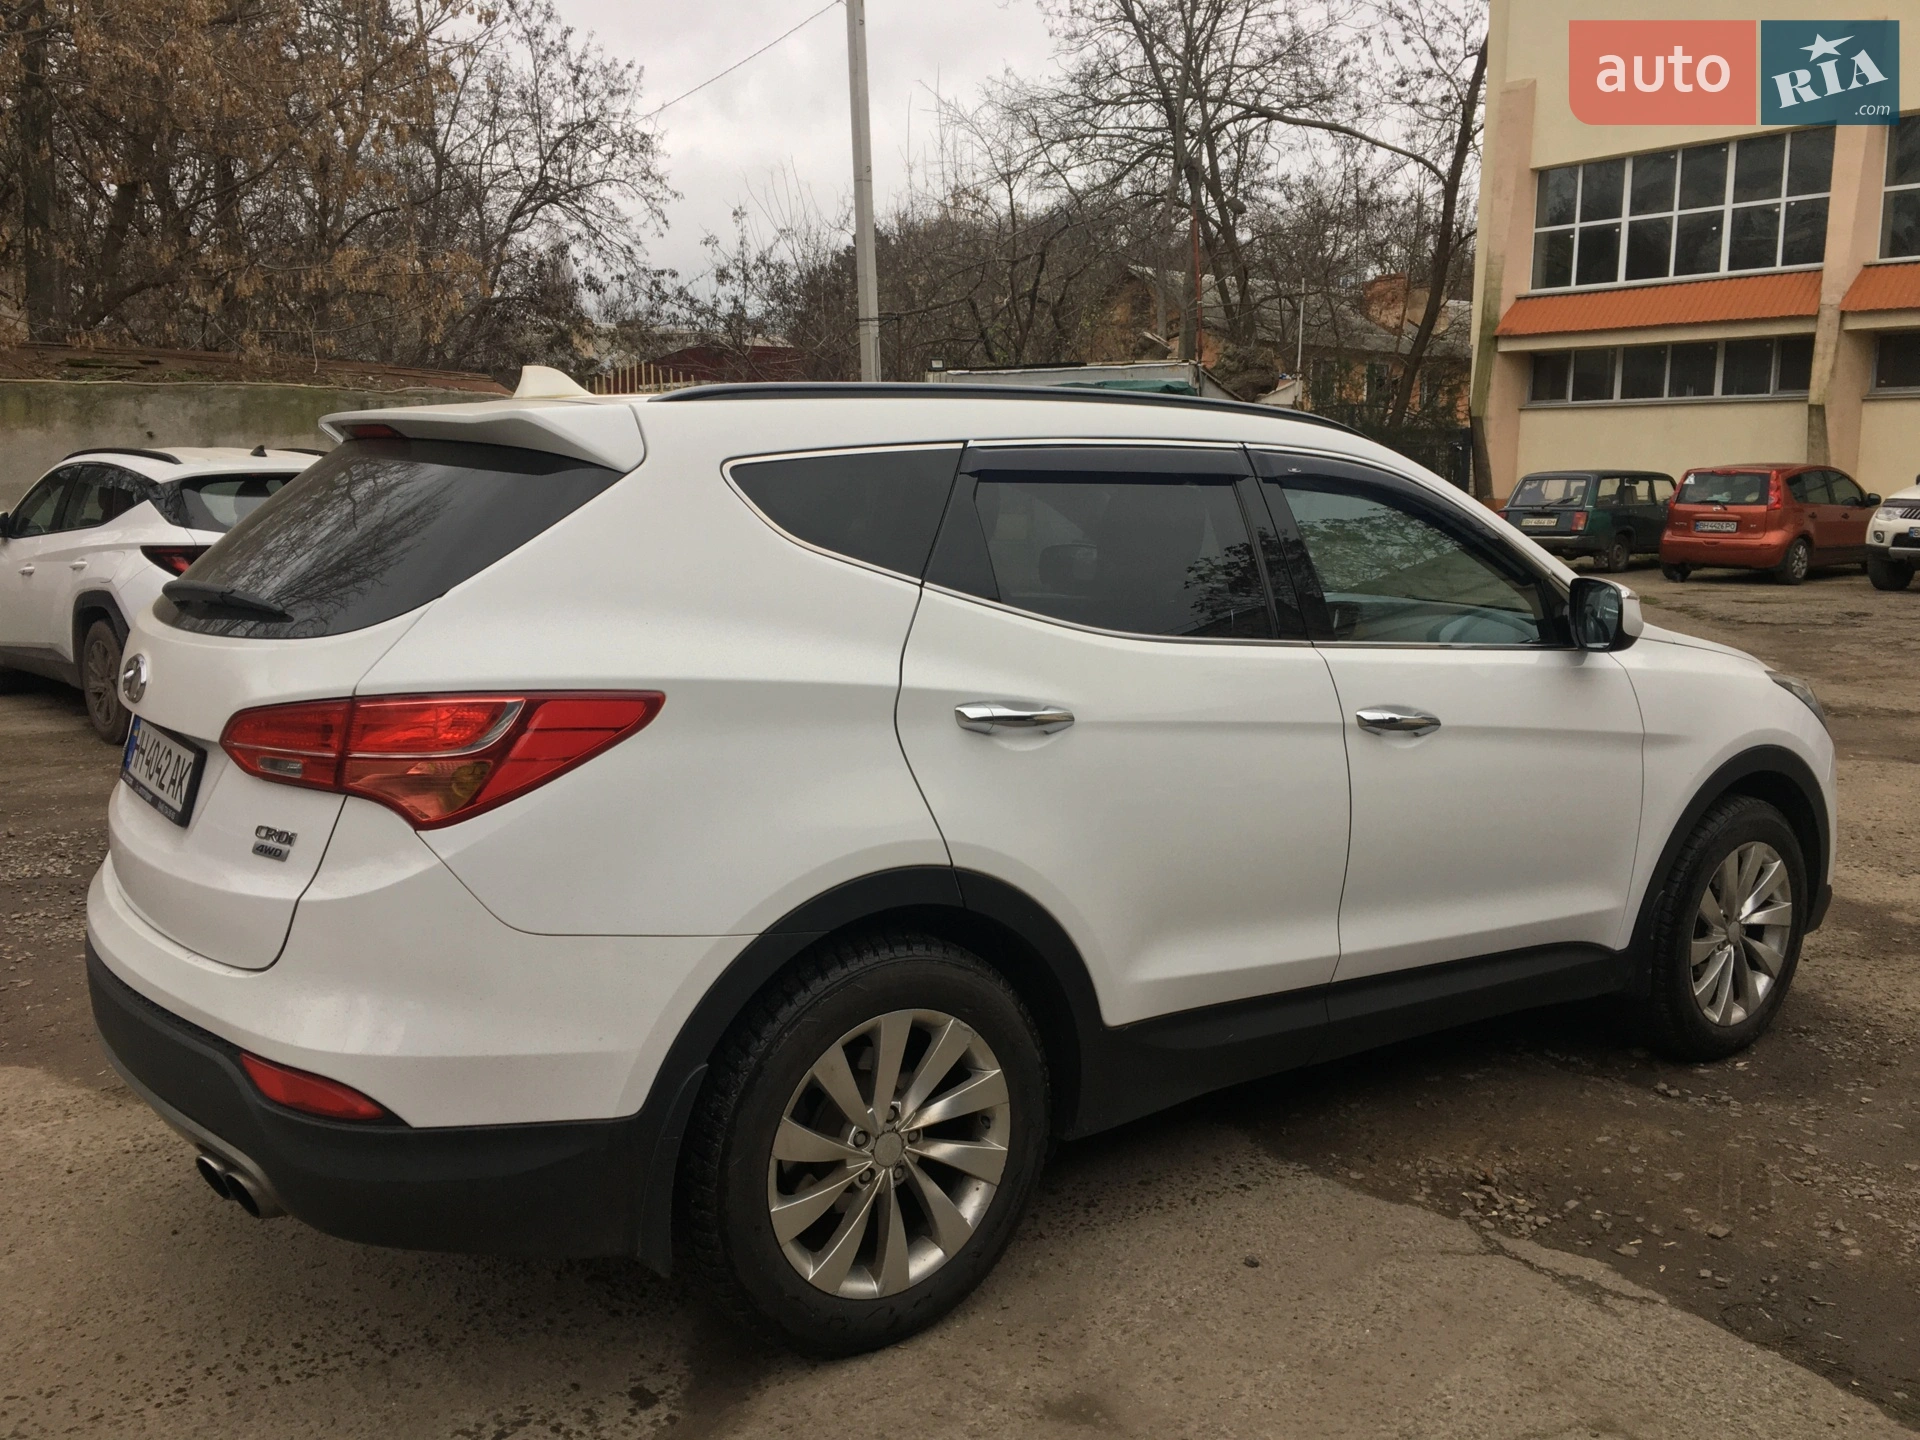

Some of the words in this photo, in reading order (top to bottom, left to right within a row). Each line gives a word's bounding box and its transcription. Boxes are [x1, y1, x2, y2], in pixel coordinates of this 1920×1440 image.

[145, 737, 173, 791] 4042
[166, 754, 193, 805] AK
[256, 844, 283, 858] 4WD
